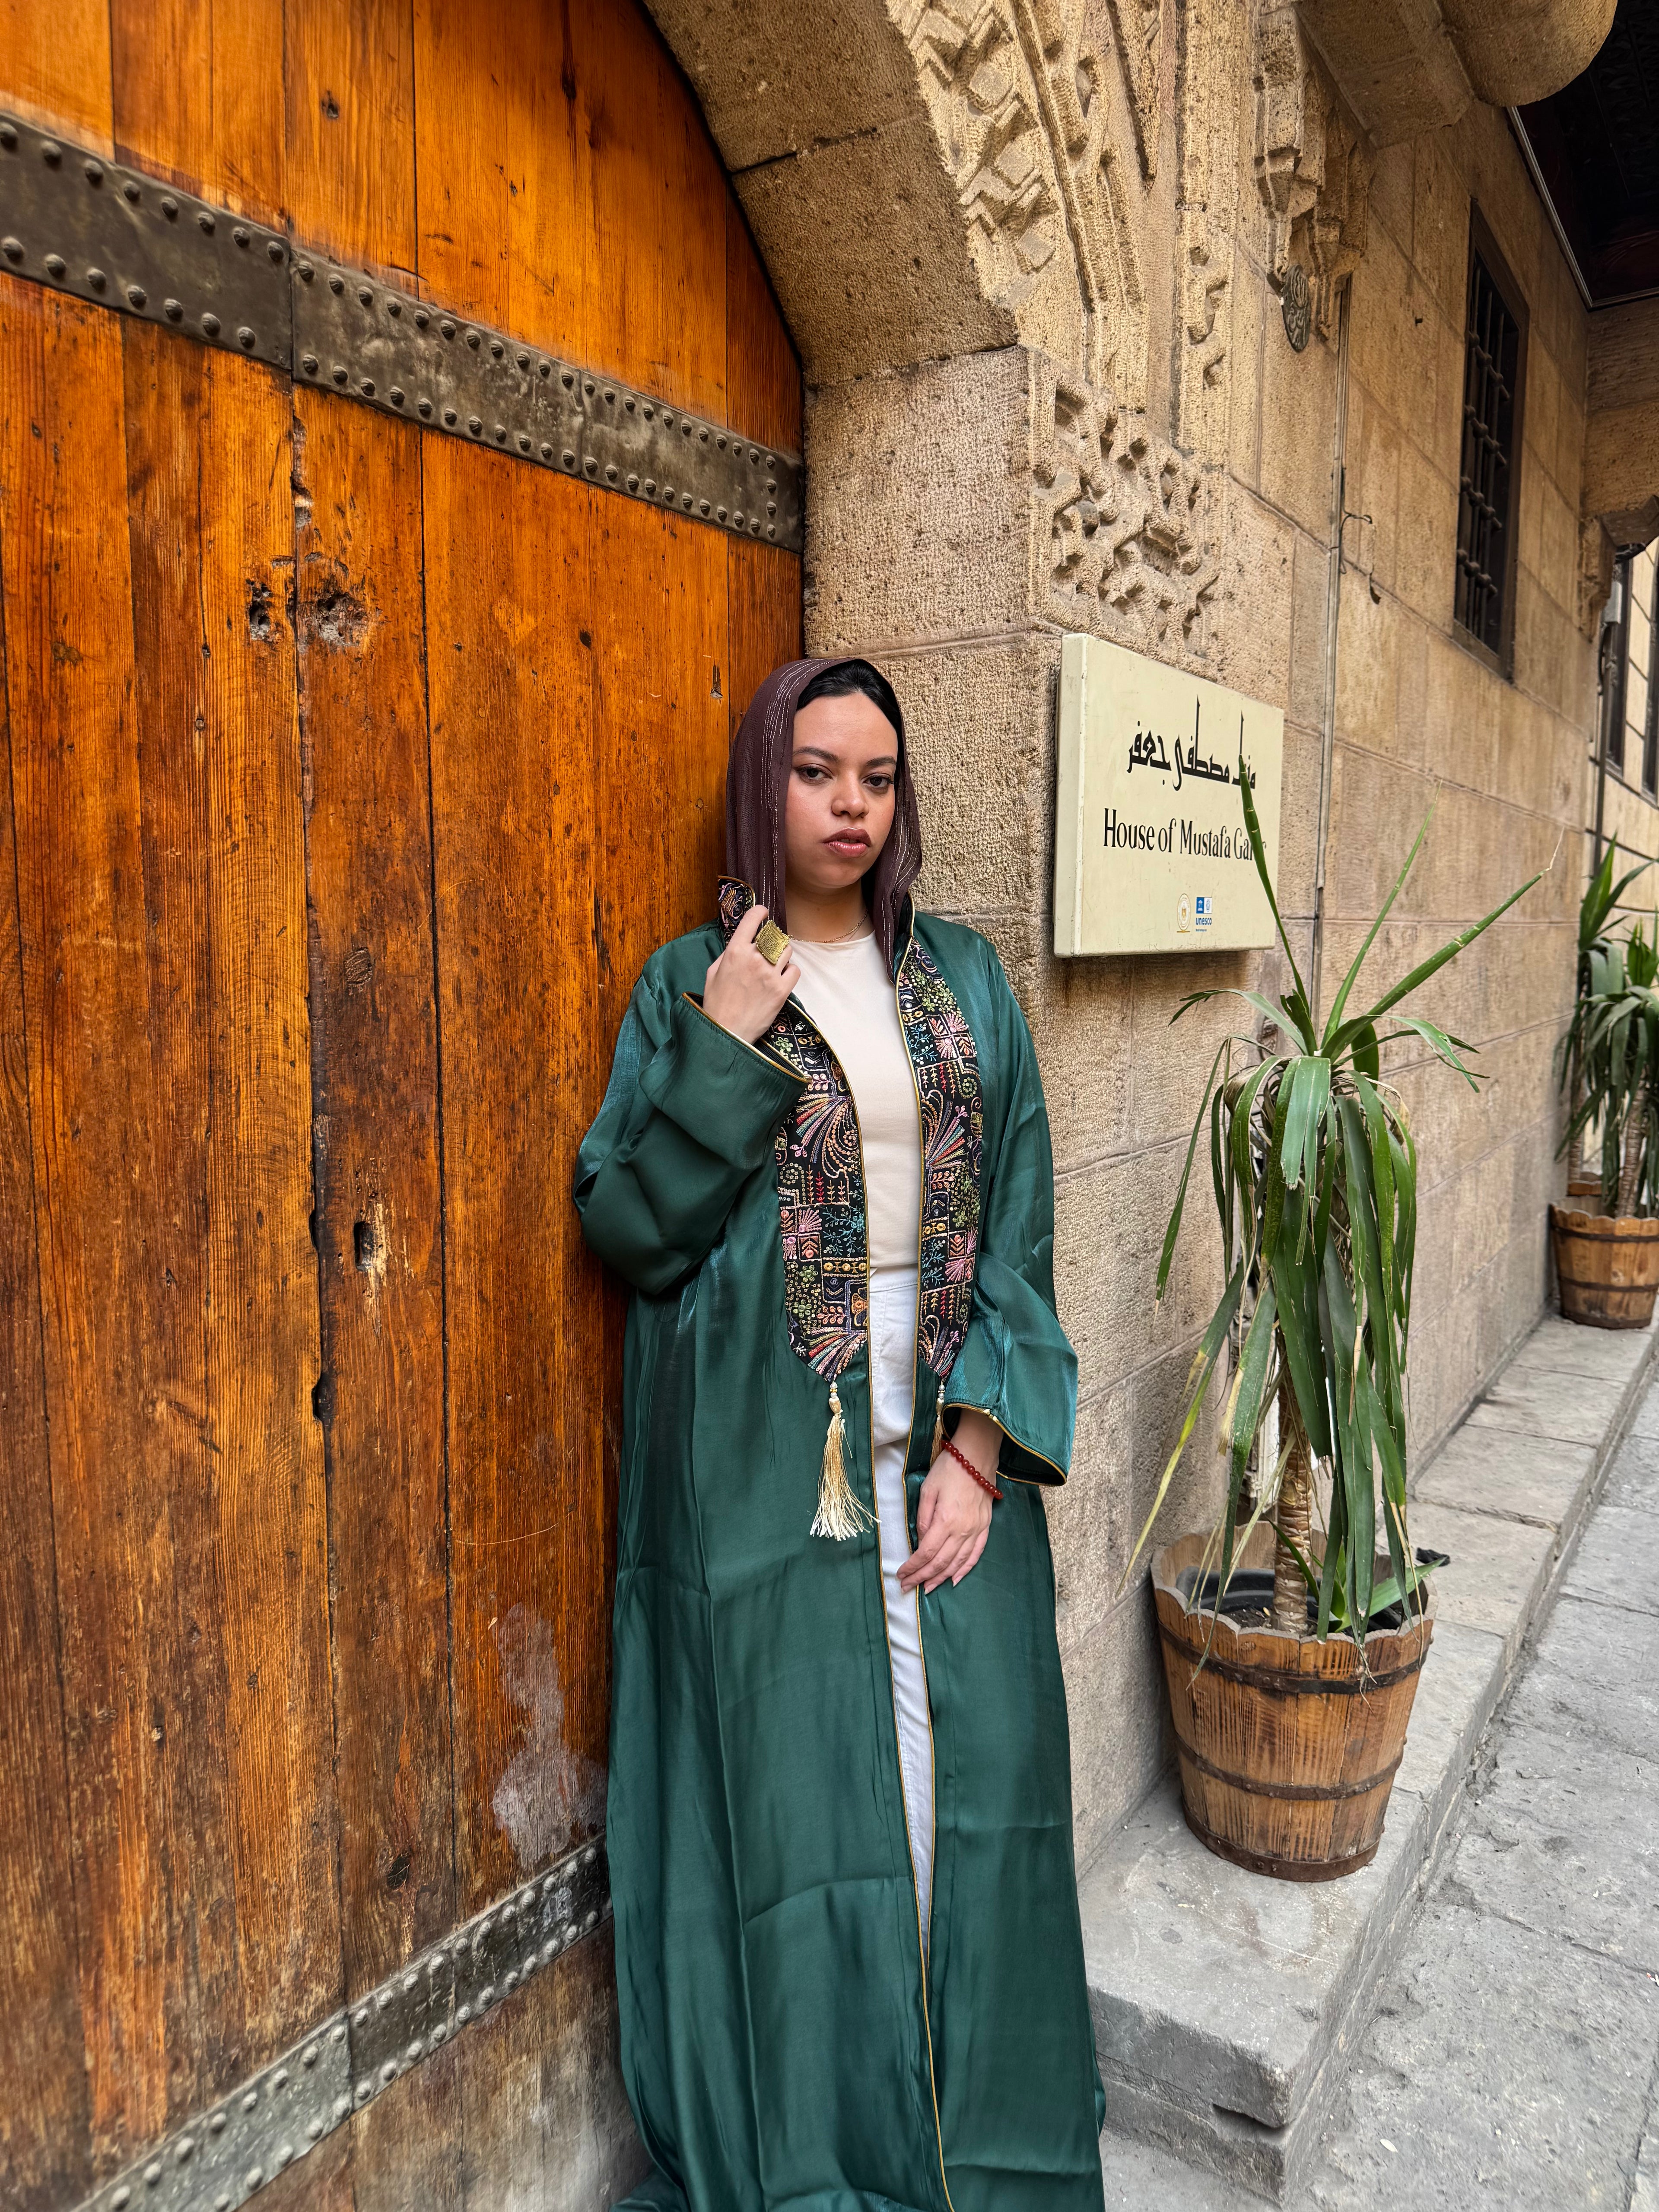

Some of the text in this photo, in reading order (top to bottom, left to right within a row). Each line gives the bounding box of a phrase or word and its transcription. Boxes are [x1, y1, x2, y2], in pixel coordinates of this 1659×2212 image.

[1127, 720, 1172, 785] جعفر
[1231, 709, 1256, 789] منل
[1103, 808, 1155, 851] House
[1158, 818, 1176, 852] of
[1180, 819, 1231, 858] Mustafa
